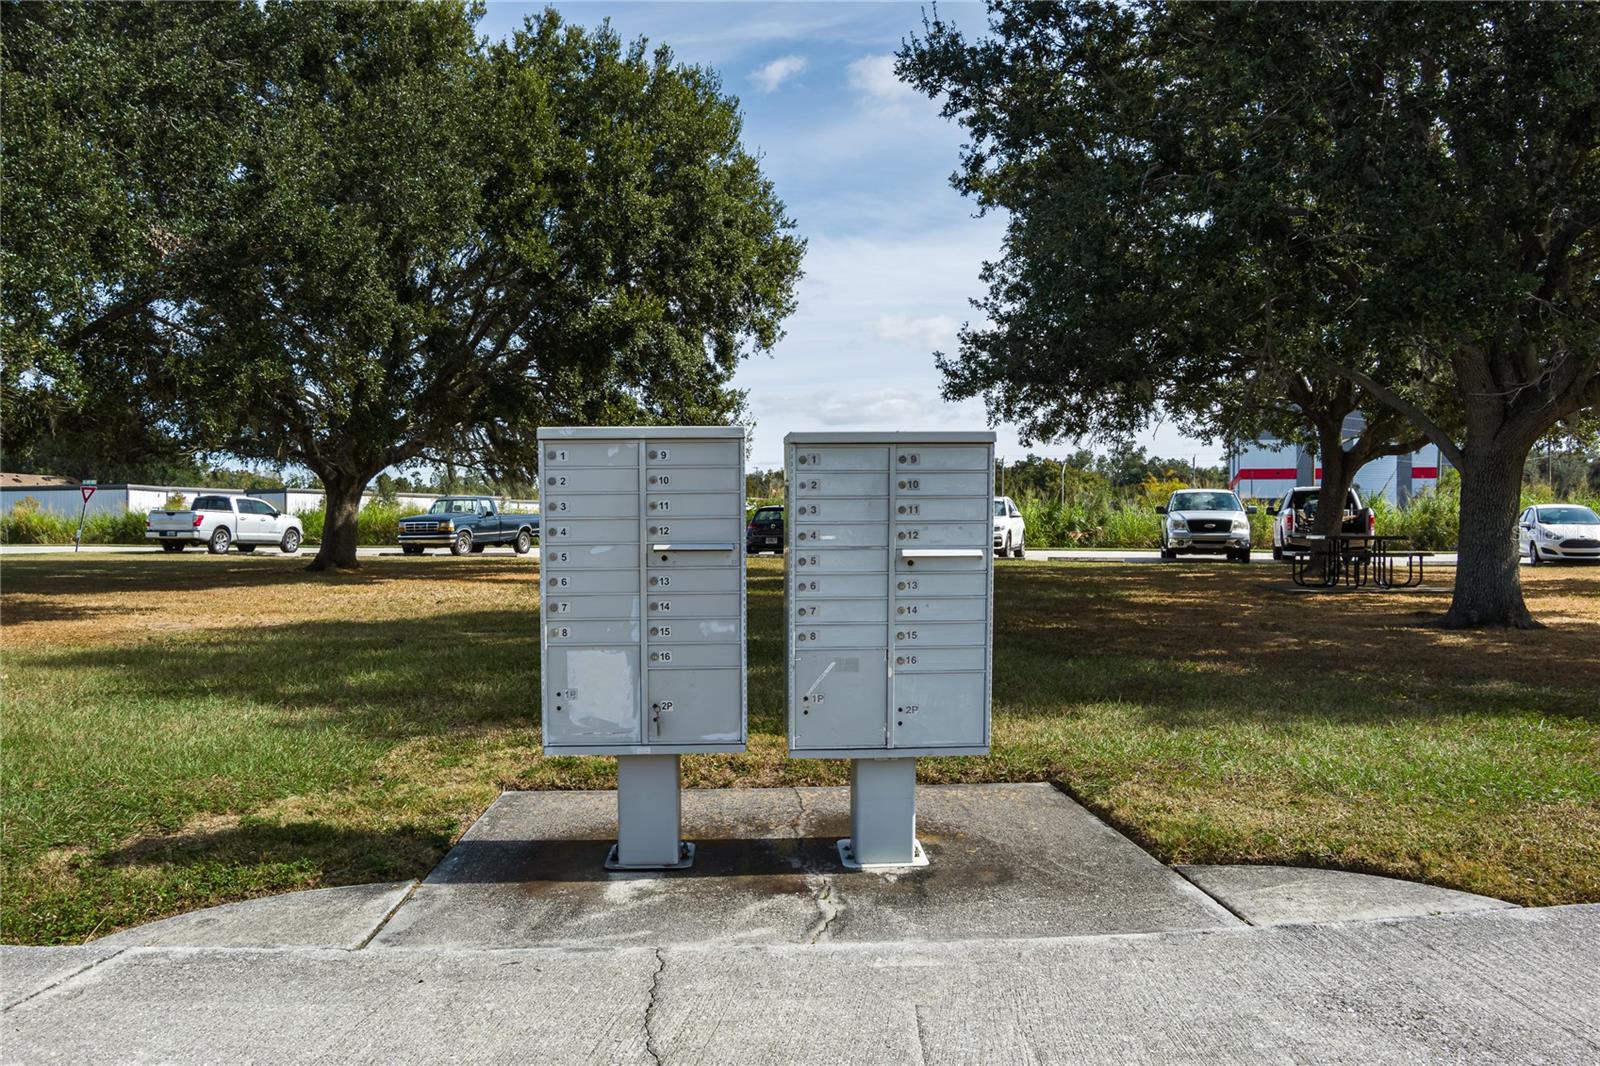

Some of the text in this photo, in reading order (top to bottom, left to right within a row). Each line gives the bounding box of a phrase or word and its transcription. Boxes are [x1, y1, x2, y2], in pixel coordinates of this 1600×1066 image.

[560, 451, 566, 461] 1
[660, 450, 667, 460] 9
[810, 455, 817, 464] 1
[910, 455, 917, 464] 9
[560, 476, 567, 486] 2
[658, 476, 670, 485] 10
[907, 480, 919, 489] 10
[810, 481, 818, 490] 2
[560, 502, 567, 511] 3
[658, 501, 670, 510] 11
[810, 505, 817, 515] 3
[908, 505, 919, 514] 11
[560, 527, 567, 536] 4
[659, 526, 670, 536] 12
[810, 531, 817, 540] 4
[907, 531, 919, 540] 12
[560, 552, 568, 562] 5
[810, 556, 817, 566] 5
[560, 577, 568, 587] 6
[659, 577, 670, 586] 13
[809, 581, 817, 590] 6
[906, 581, 918, 590] 13
[561, 603, 568, 612] 7
[659, 602, 671, 611] 14
[906, 606, 918, 615] 14
[809, 607, 817, 616] 7
[561, 628, 568, 638] 8
[659, 627, 671, 636] 15
[906, 631, 918, 640] 15
[809, 632, 817, 641] 8
[659, 652, 671, 661] 16
[905, 656, 917, 665] 16
[811, 695, 824, 703] 1P
[661, 701, 673, 711] 2P
[905, 706, 919, 715] 2P
